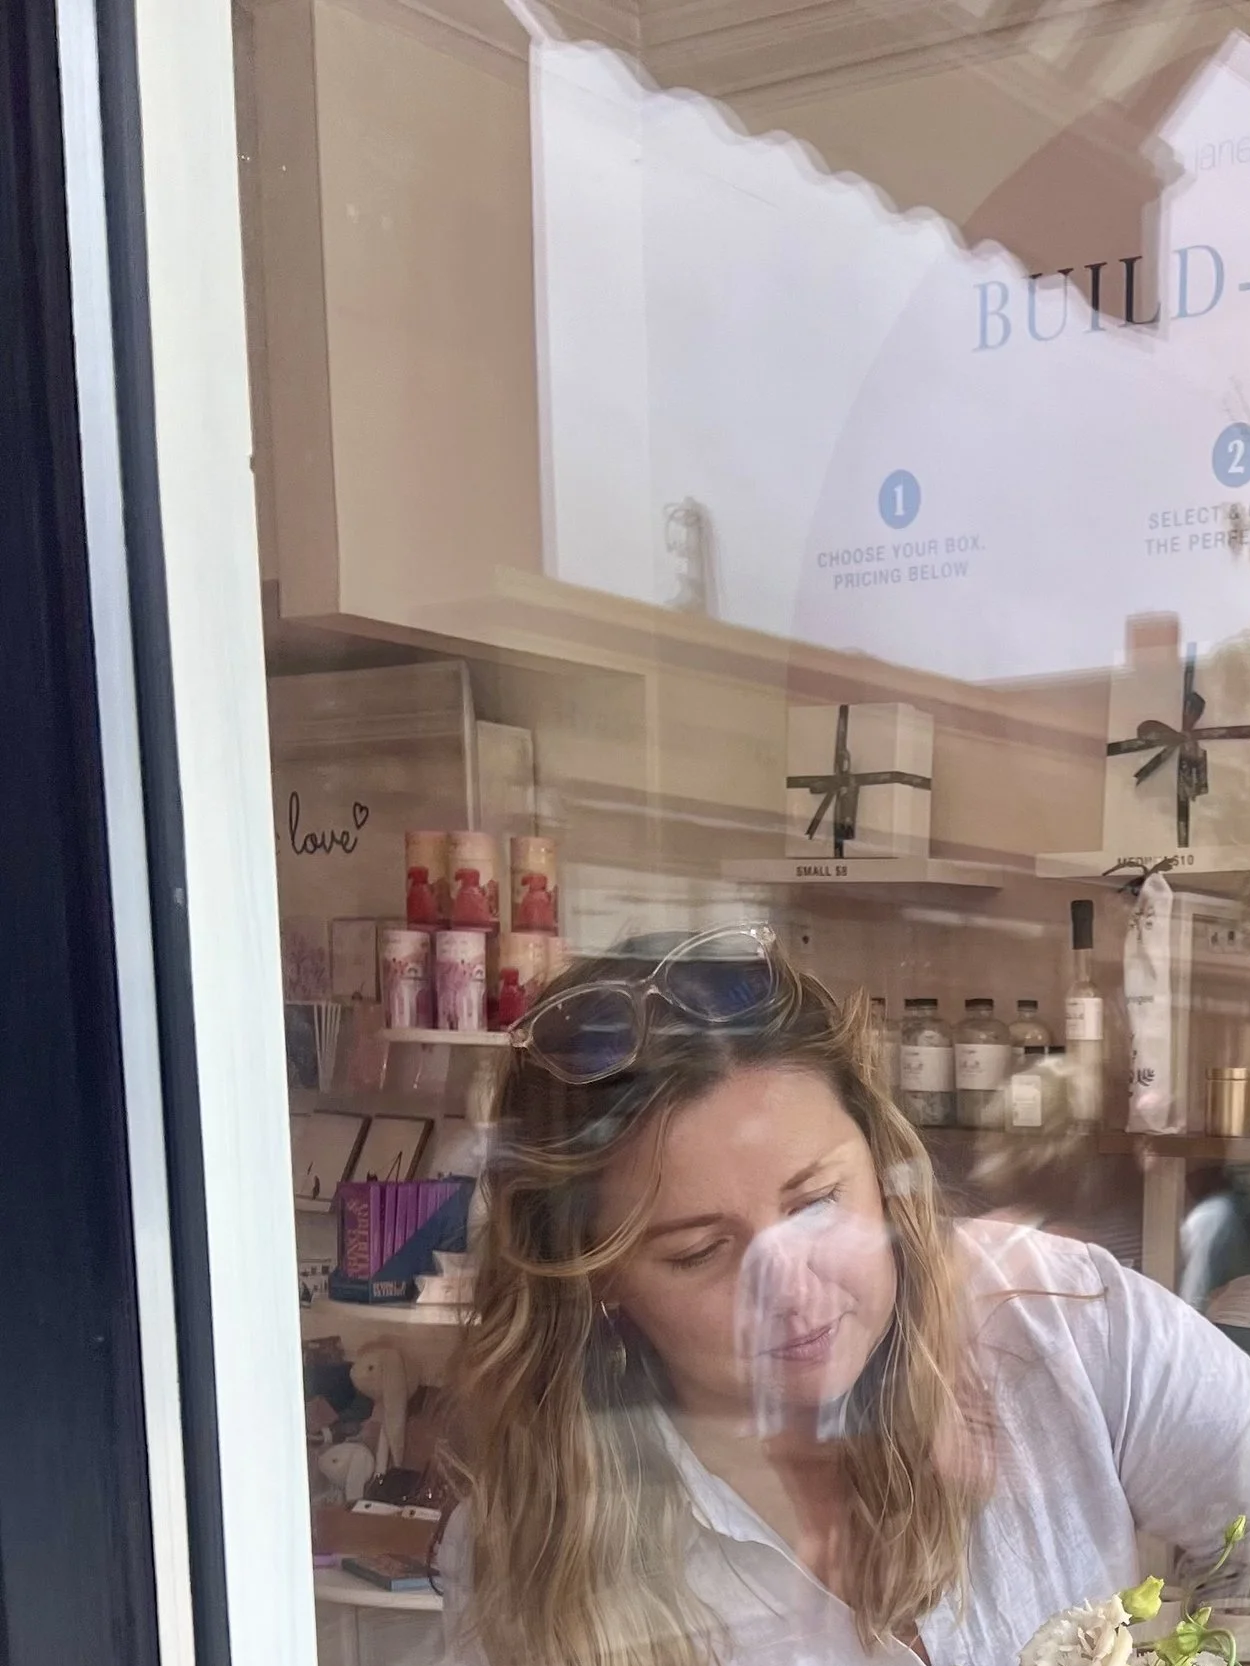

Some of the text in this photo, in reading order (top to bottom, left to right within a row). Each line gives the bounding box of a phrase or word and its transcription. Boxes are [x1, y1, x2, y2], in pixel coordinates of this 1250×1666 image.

[1227, 439, 1245, 474] 2
[1148, 506, 1221, 530] SELECT
[1228, 504, 1240, 521] &
[817, 534, 987, 568] CHOOSE YOUR BOX.
[1144, 536, 1181, 556] THE
[833, 561, 969, 590] PRICING BELOW
[289, 790, 358, 855] love
[796, 865, 832, 877] SMALL
